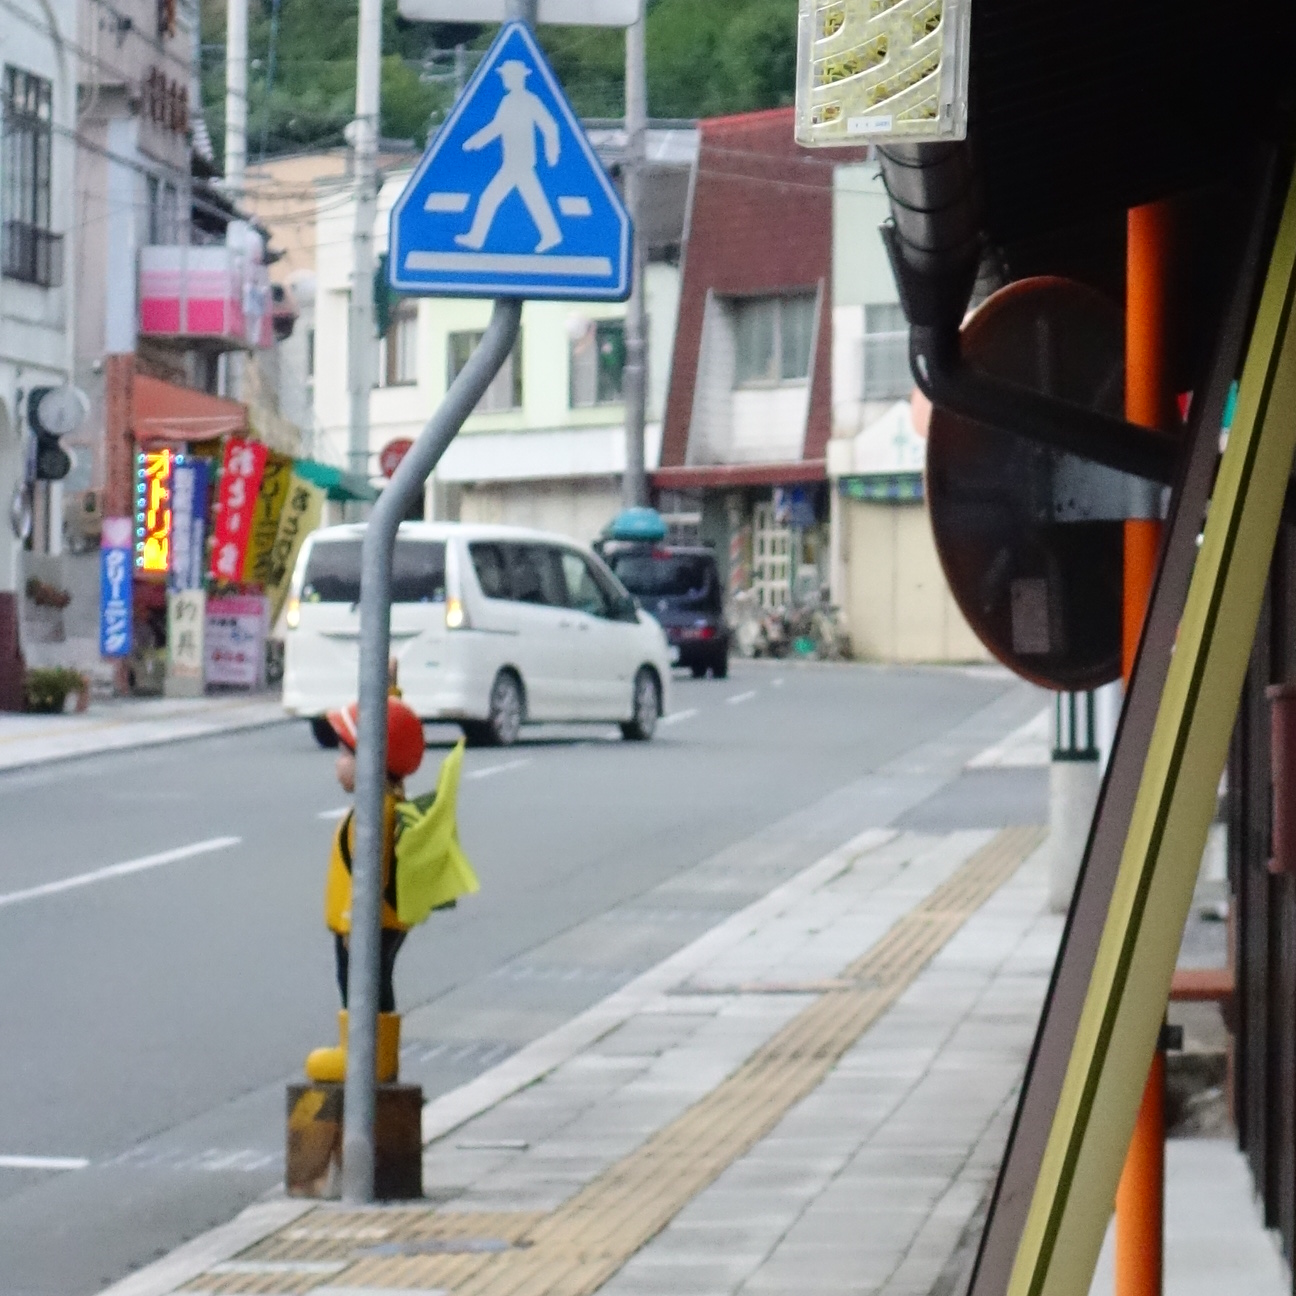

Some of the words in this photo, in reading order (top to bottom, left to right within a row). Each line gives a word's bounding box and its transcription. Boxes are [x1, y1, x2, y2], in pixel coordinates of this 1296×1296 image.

[104, 549, 127, 653] クリーニング
